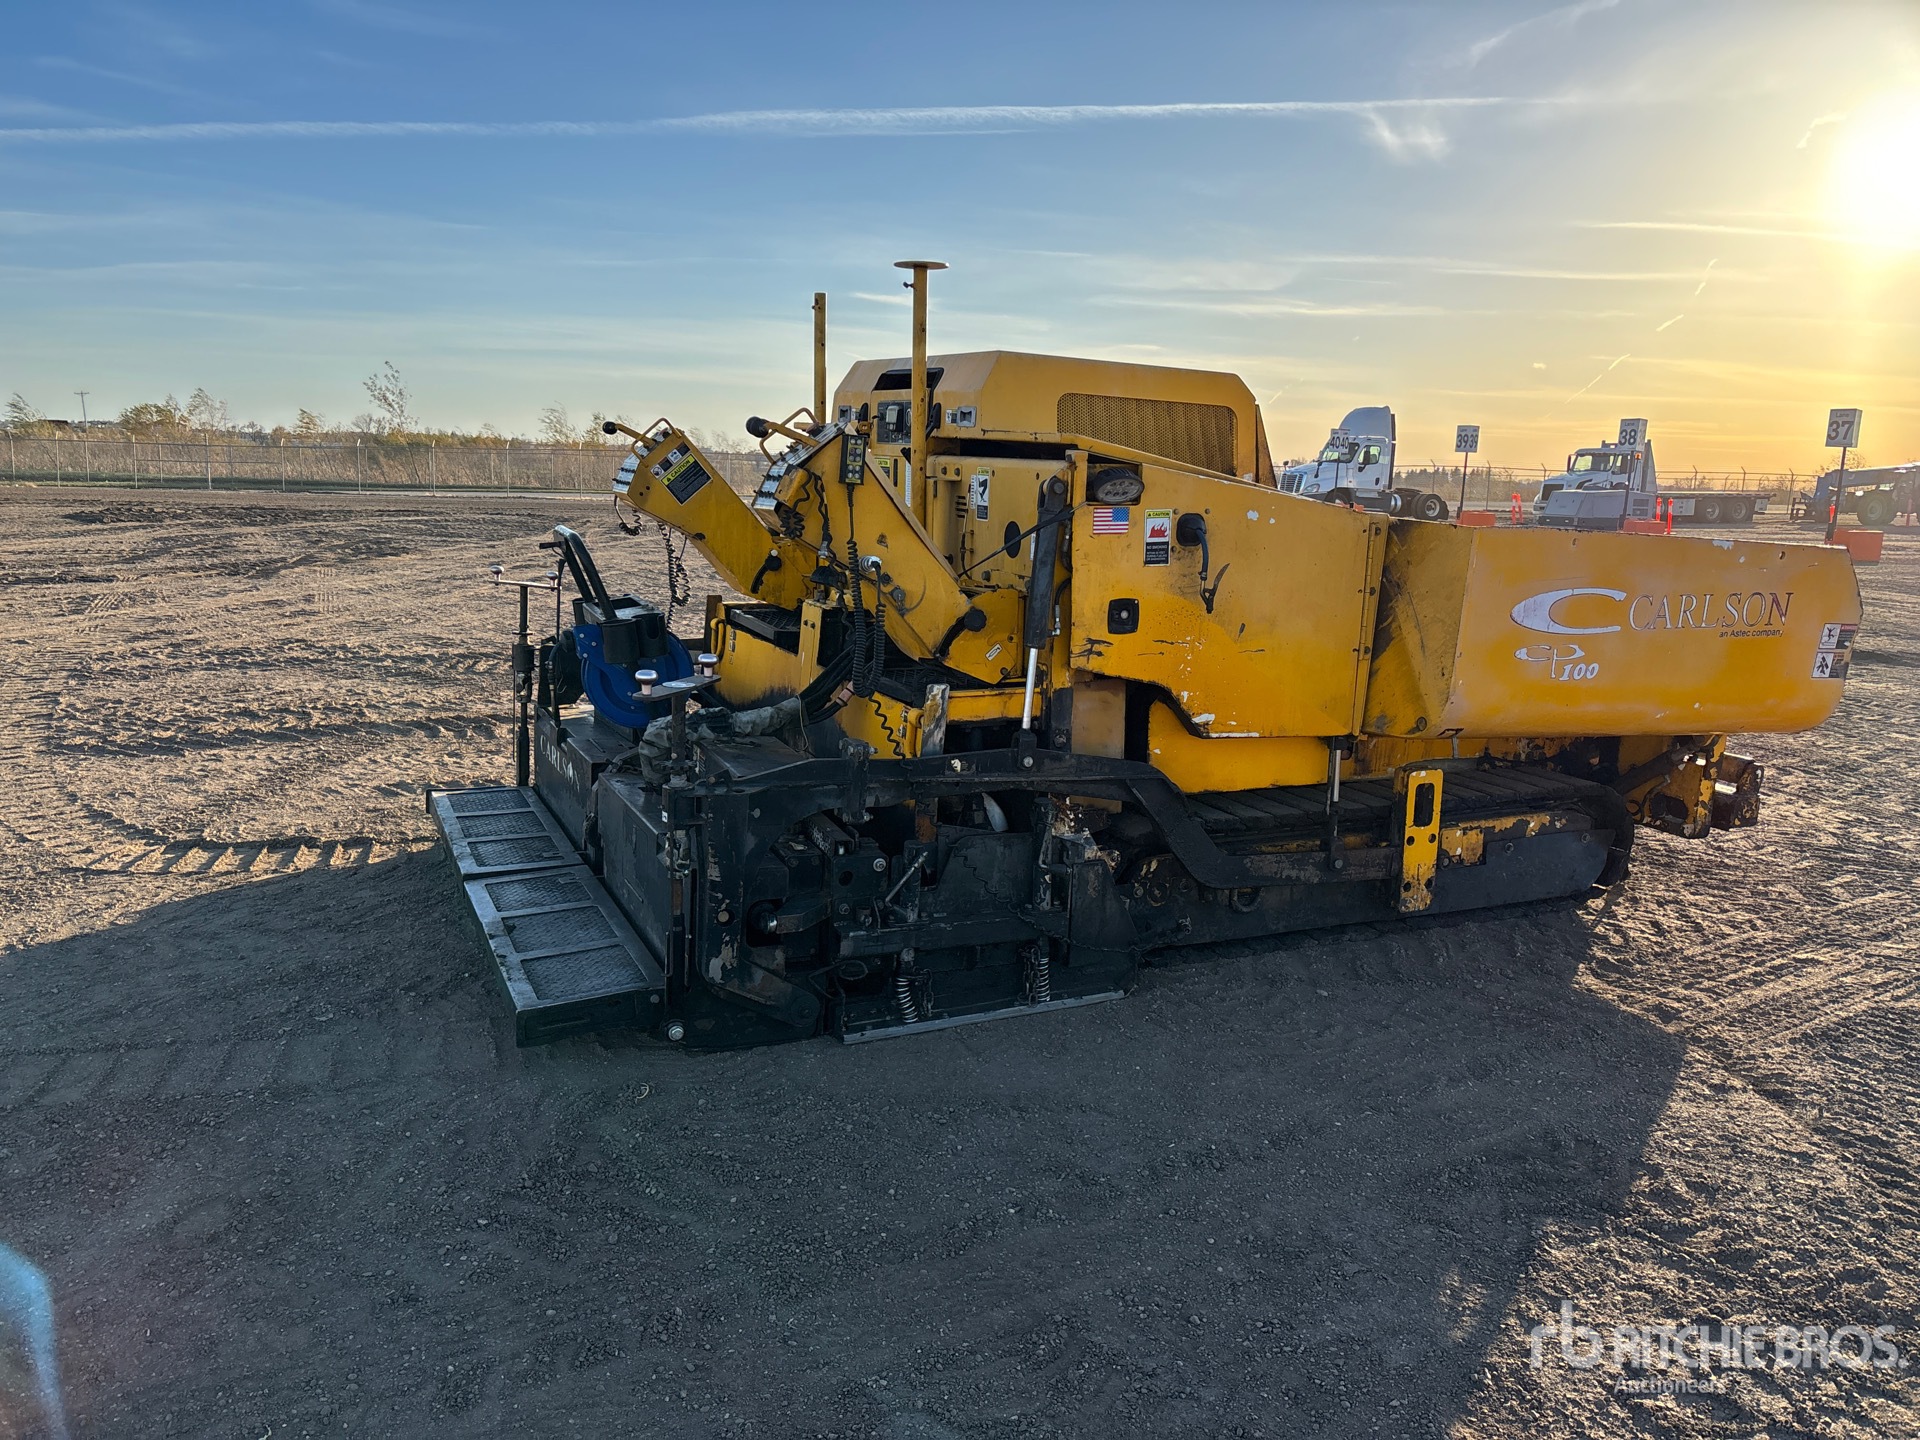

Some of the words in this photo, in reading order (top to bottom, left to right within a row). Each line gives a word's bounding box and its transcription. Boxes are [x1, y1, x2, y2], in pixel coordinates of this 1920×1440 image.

[1618, 429, 1637, 446] 38
[1828, 420, 1855, 441] 37
[1329, 436, 1341, 449] 40
[1456, 433, 1469, 448] 39
[670, 459, 691, 478] CAUTION
[1628, 591, 1795, 631] CARLSON
[1730, 629, 1751, 638] Astec
[1558, 662, 1600, 681] 100
